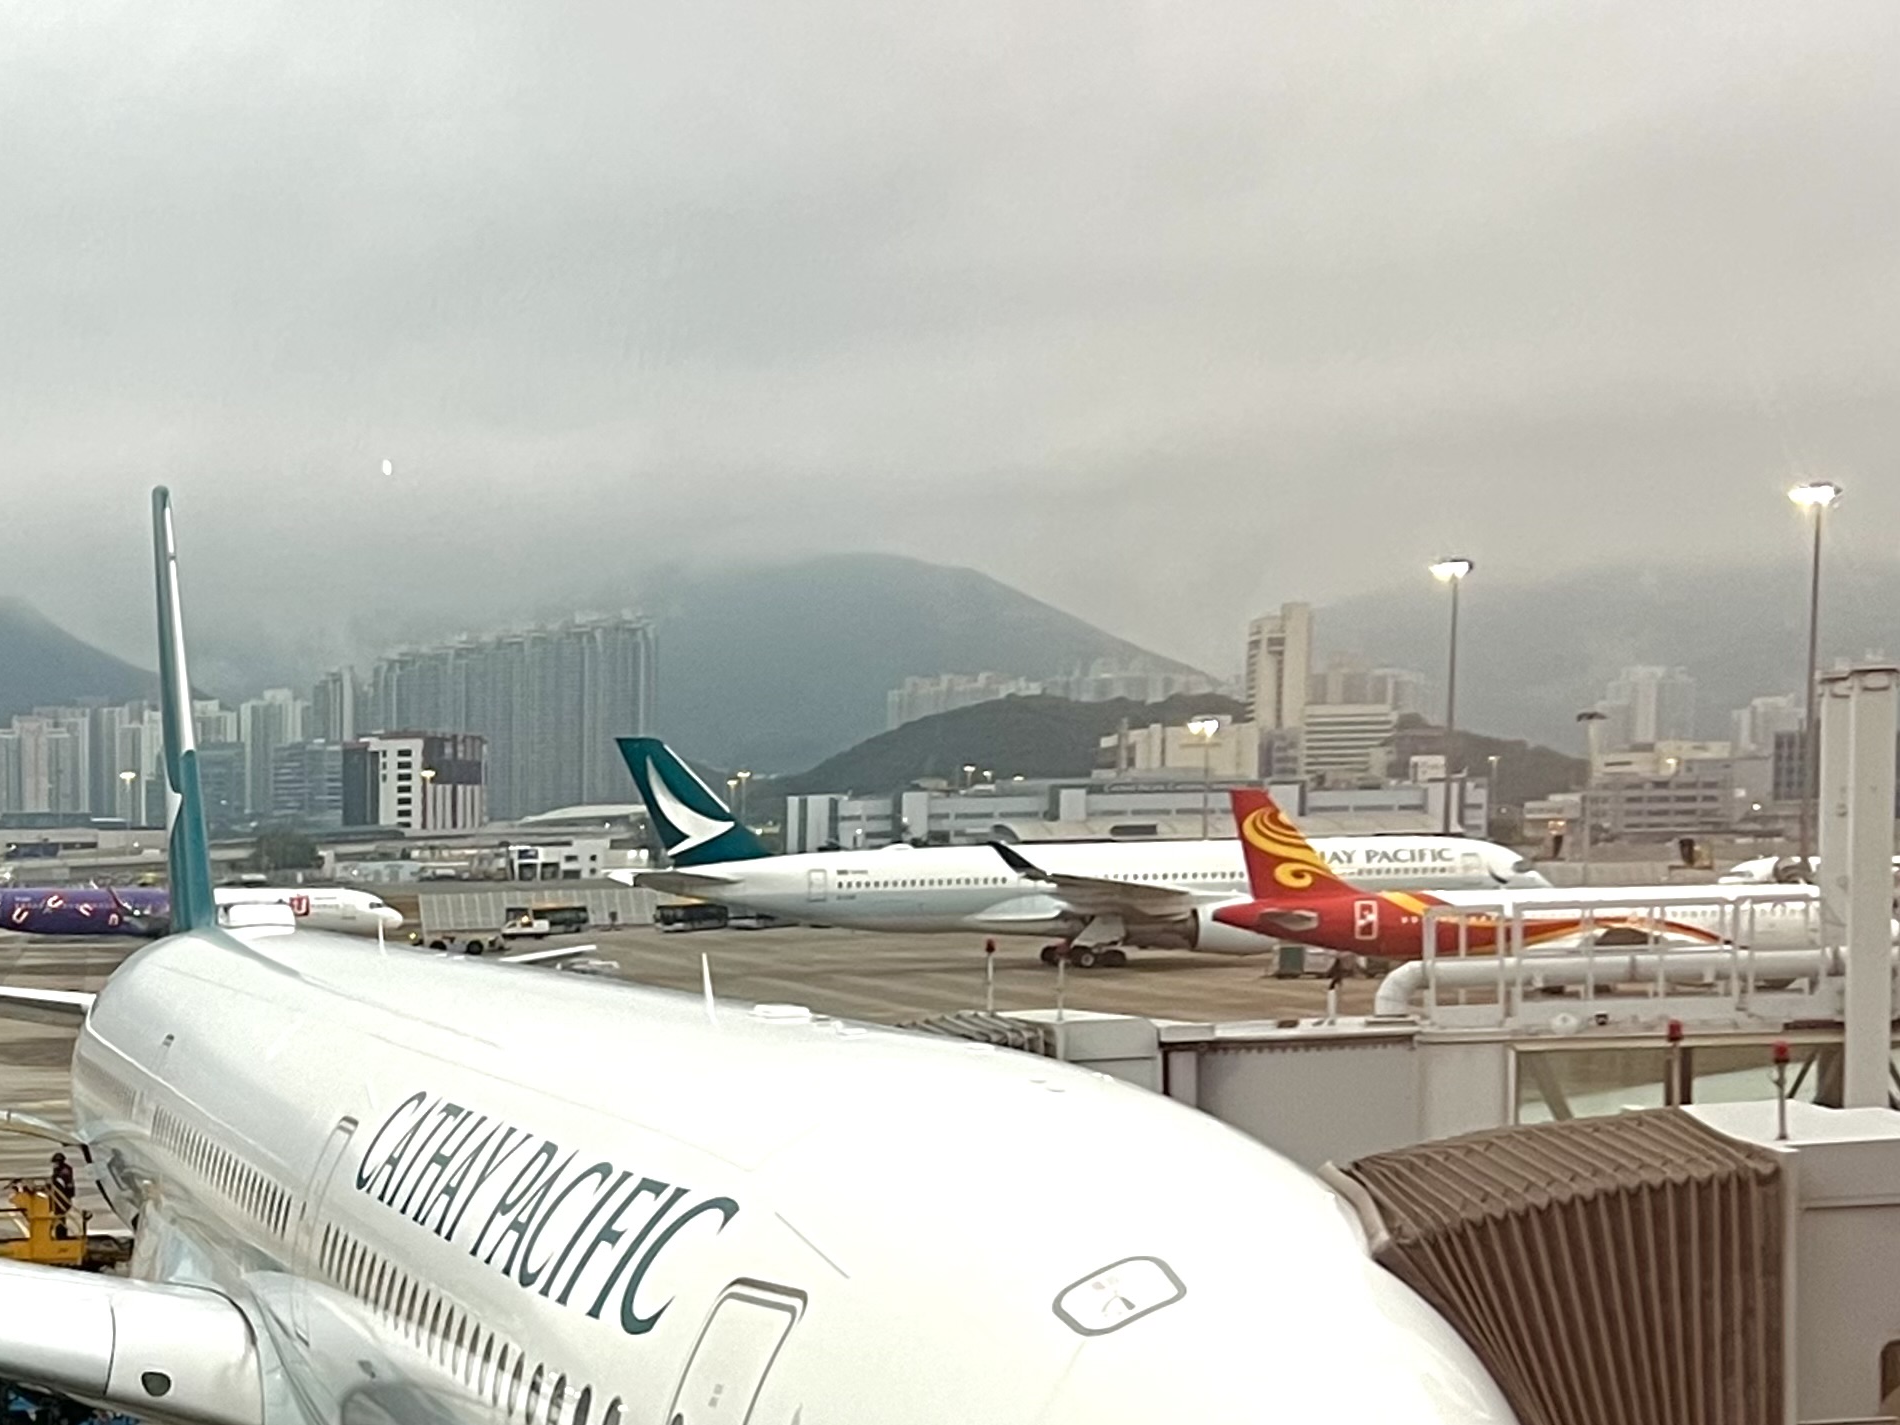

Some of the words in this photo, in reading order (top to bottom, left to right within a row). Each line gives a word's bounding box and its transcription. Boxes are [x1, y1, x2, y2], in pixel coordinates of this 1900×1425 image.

[1365, 848, 1453, 864] PACIFIC
[356, 1091, 534, 1242] CATHAY
[469, 1140, 740, 1336] PACIFIC
